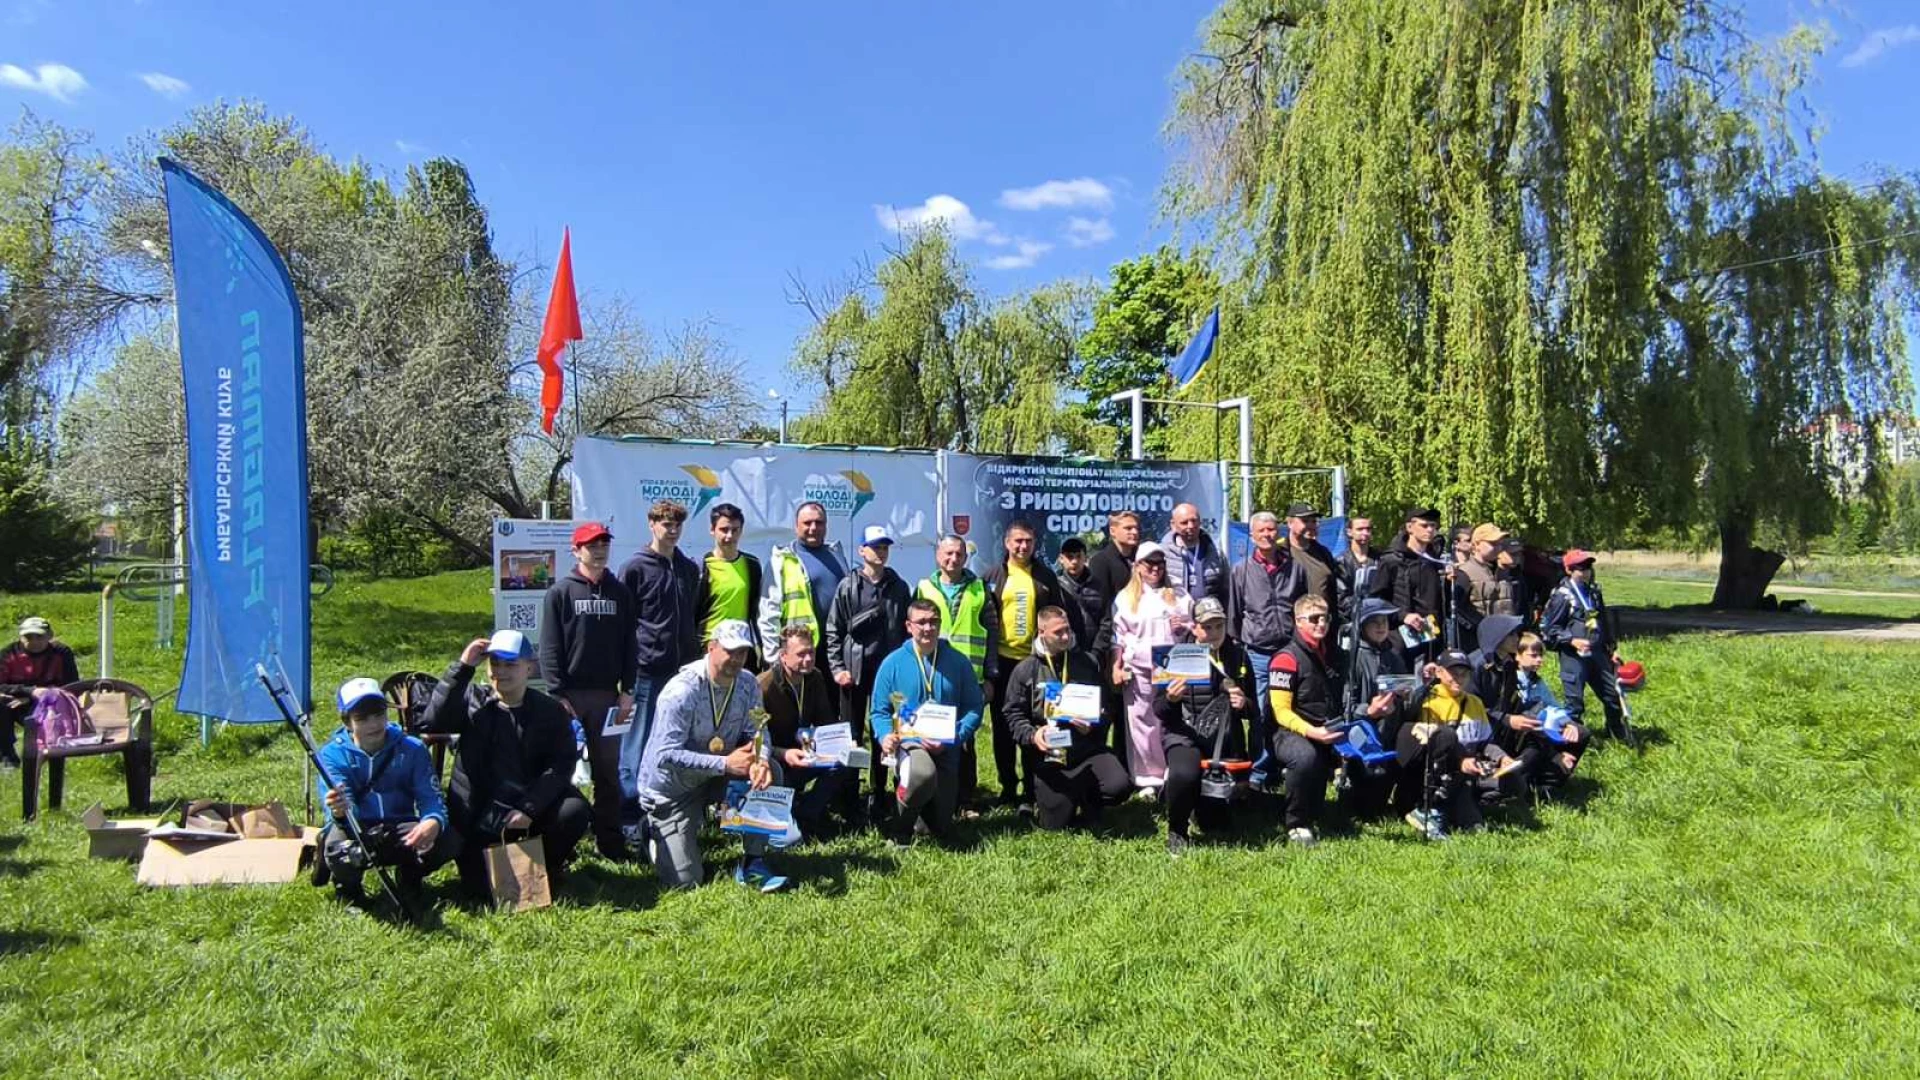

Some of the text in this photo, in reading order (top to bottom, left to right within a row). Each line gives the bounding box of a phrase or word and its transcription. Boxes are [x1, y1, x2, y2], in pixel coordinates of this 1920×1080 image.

[642, 486, 695, 497] МОЛОДІ
[805, 490, 852, 500] МОЛОДІ
[1020, 492, 1174, 512] РИБОЛОВНОГО
[1046, 515, 1108, 533] СПОР
